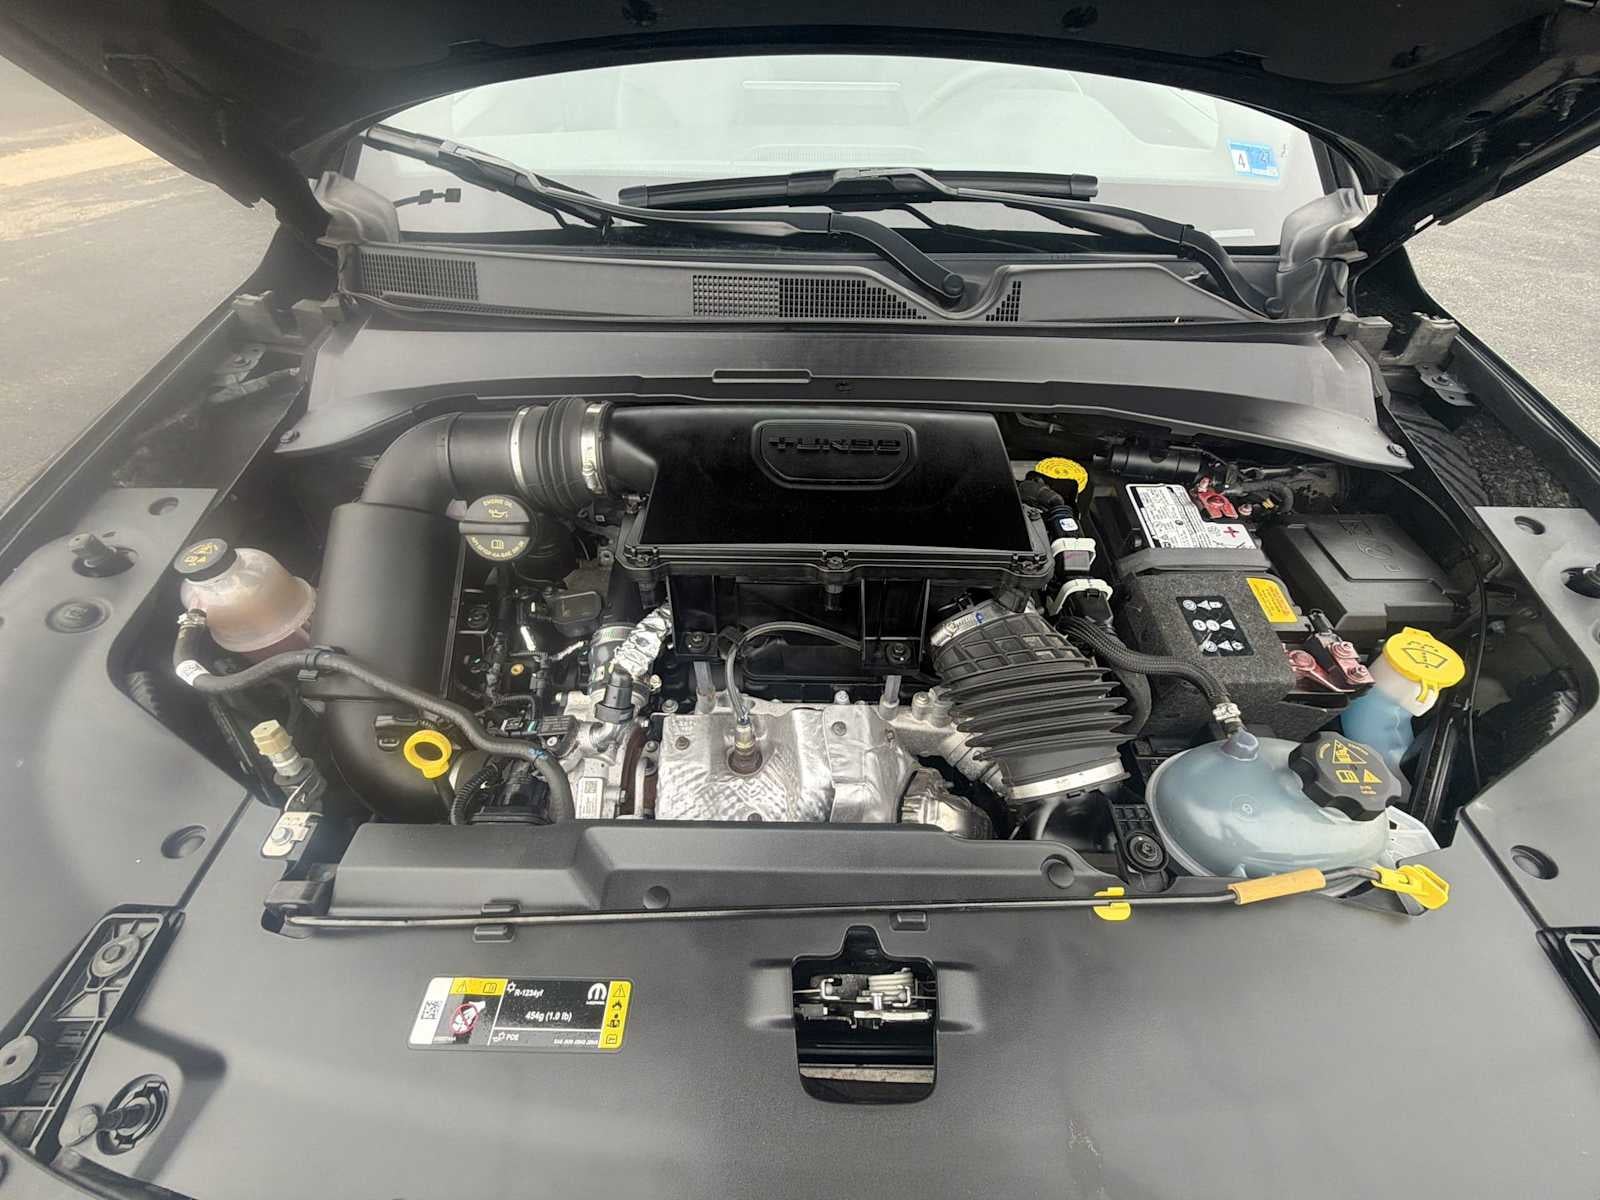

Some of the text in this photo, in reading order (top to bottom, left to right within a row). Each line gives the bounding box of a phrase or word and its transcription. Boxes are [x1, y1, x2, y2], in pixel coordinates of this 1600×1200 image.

[514, 988, 544, 998] R-1234yf
[525, 1011, 573, 1022] 454g (1.0 lb)
